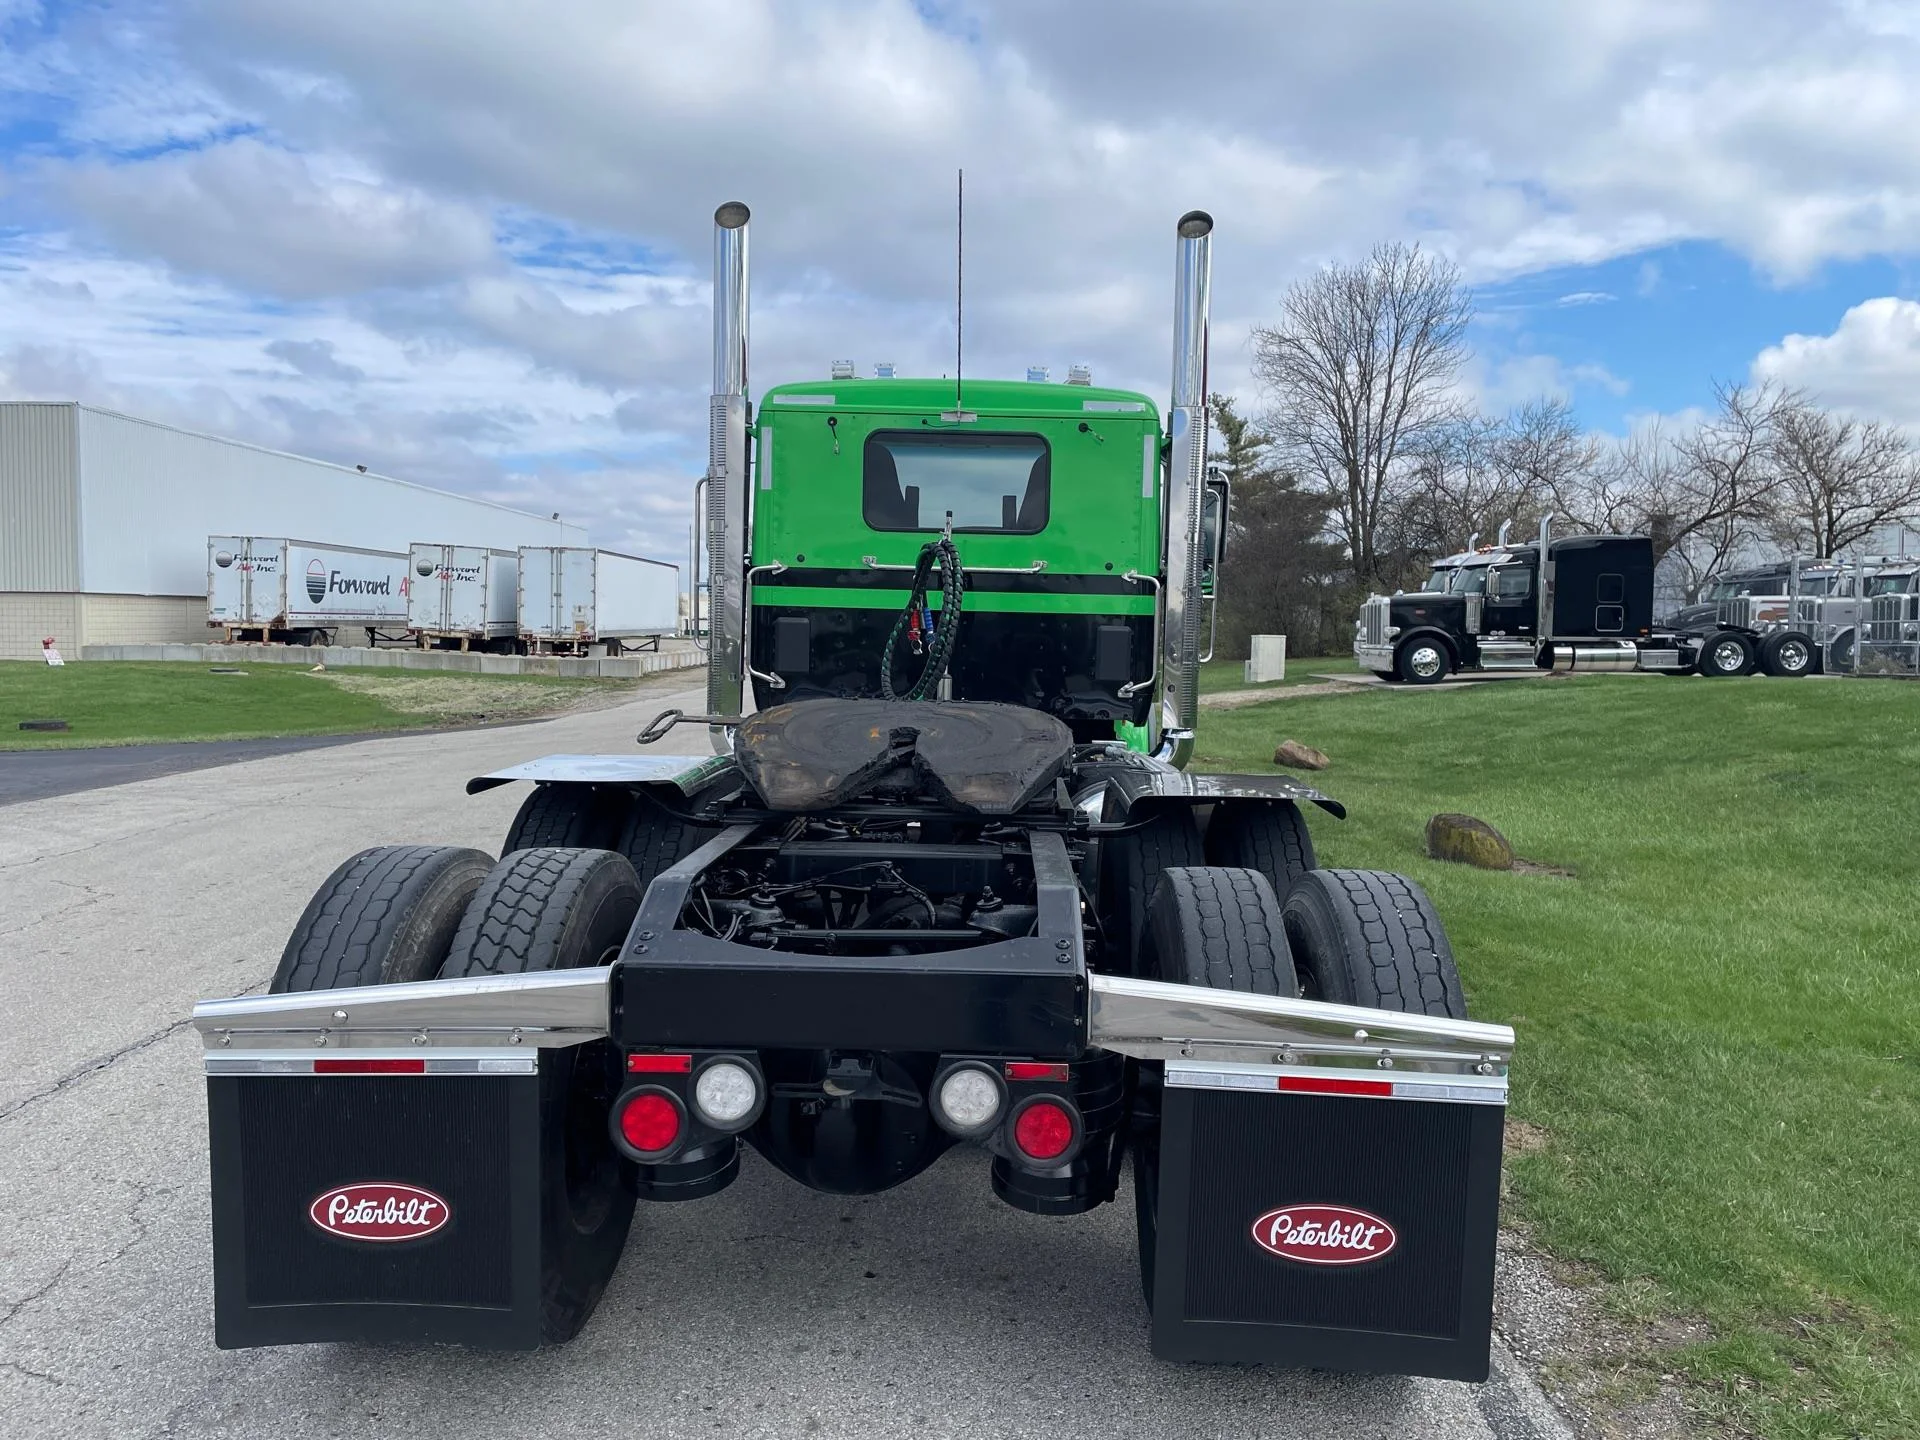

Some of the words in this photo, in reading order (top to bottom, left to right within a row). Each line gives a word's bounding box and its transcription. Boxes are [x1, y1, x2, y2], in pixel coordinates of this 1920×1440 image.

[328, 569, 391, 596] Forward
[328, 1194, 438, 1226] Peterbilt
[1270, 1214, 1384, 1250] Peterbilt
